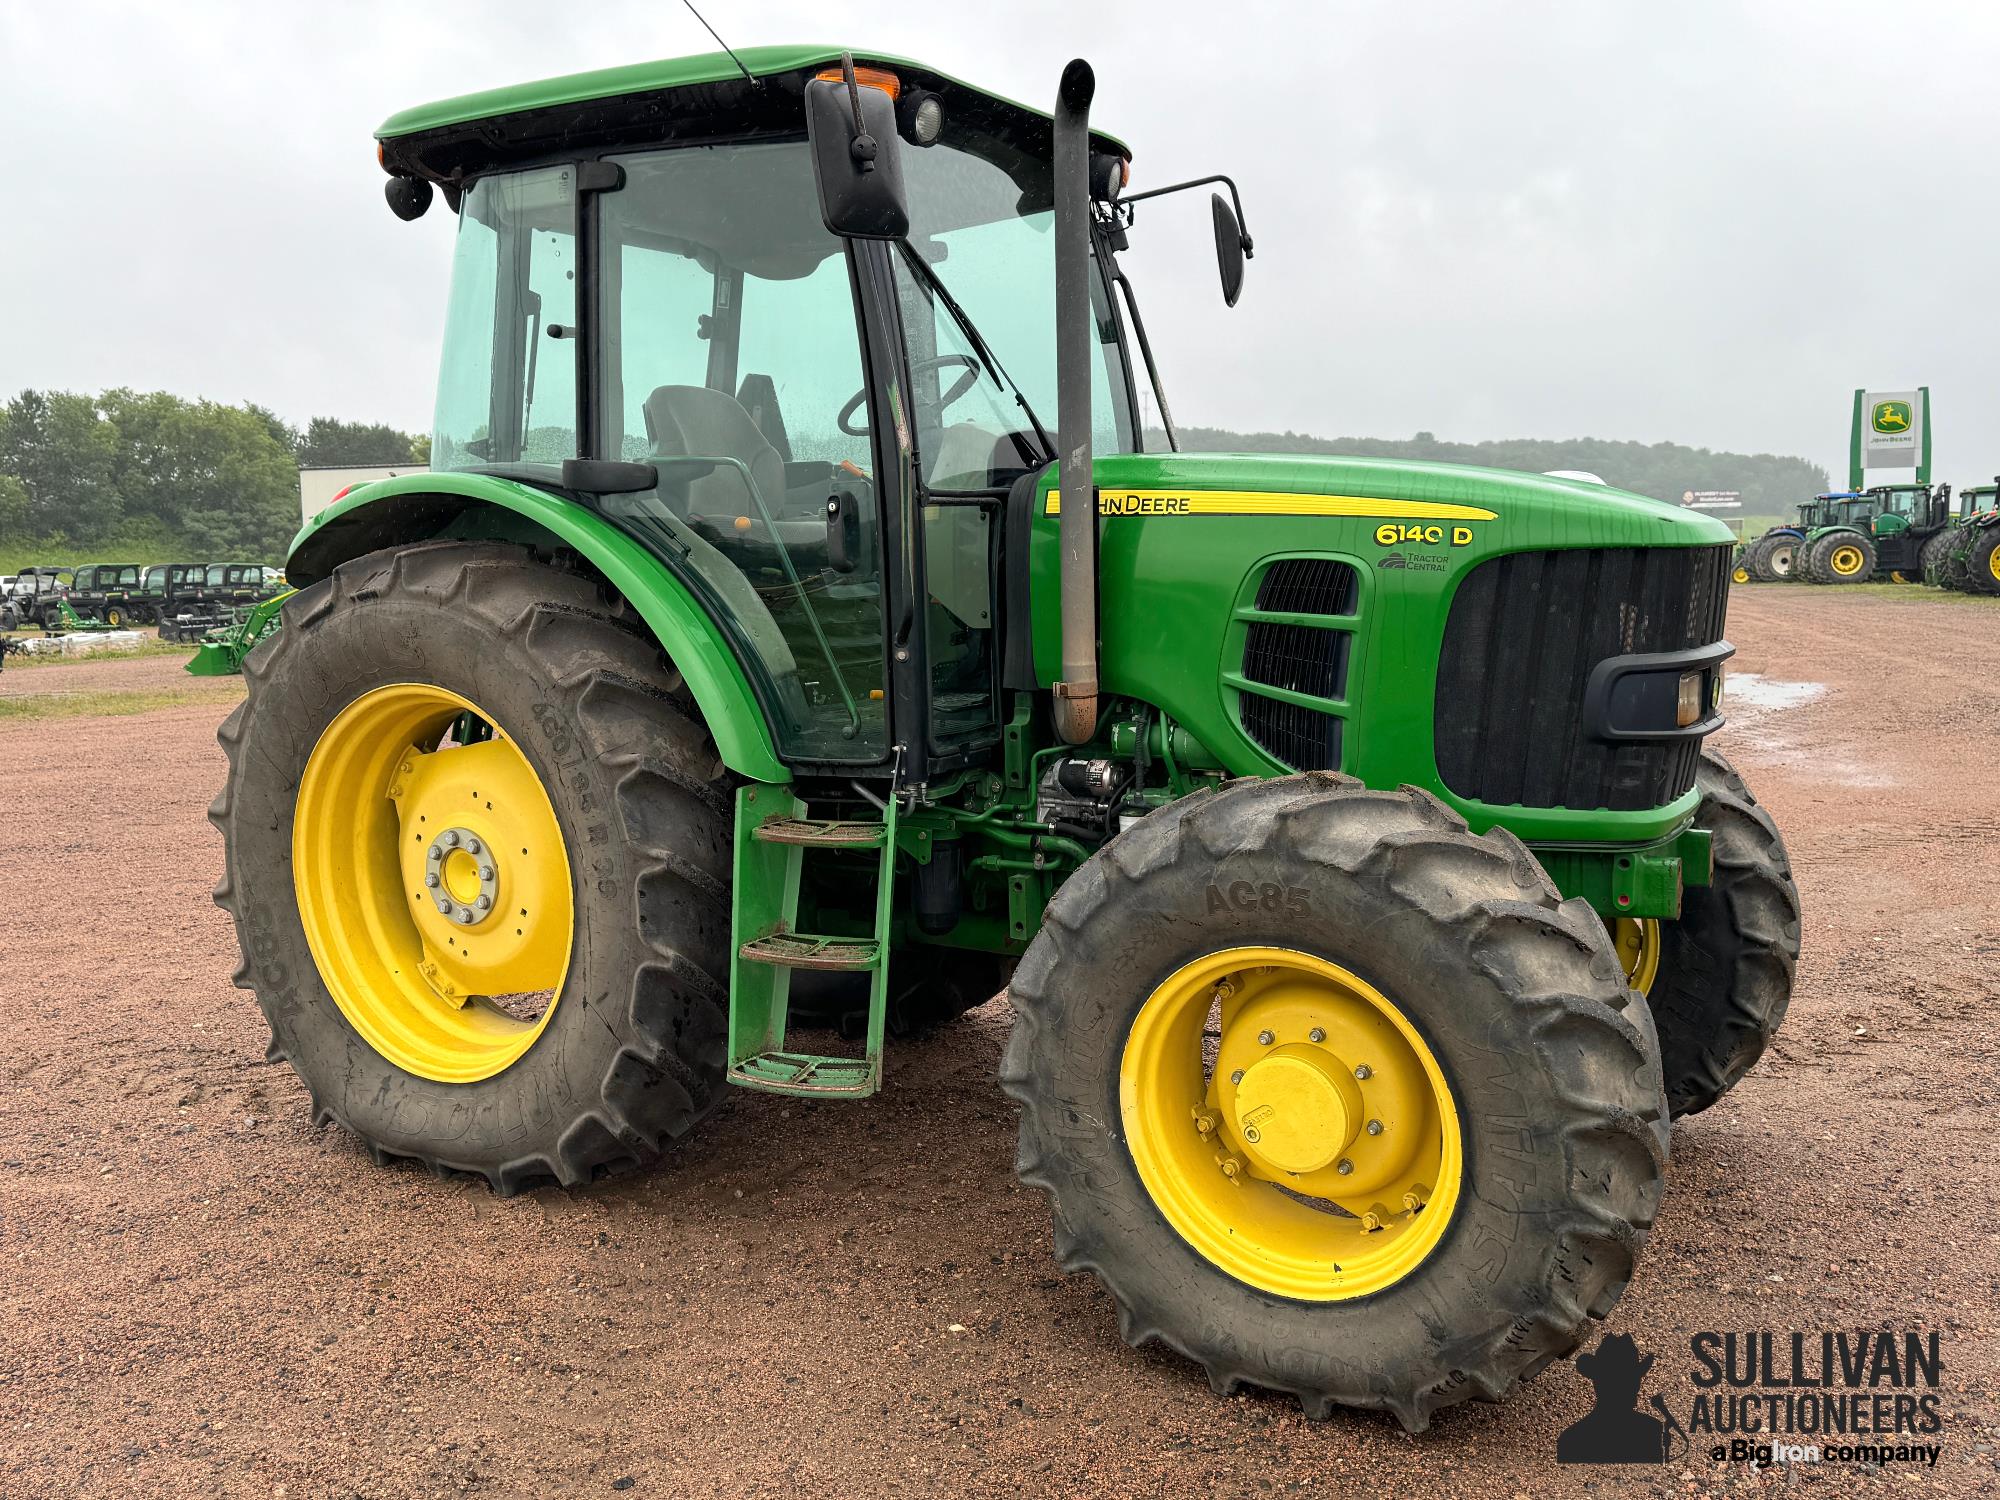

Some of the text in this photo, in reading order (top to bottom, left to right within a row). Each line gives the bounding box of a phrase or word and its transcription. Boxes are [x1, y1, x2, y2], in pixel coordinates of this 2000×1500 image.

[1126, 495, 1190, 512] DEERE
[1373, 524, 1474, 547] 6140 D
[1407, 552, 1449, 563] TRACTOR
[1406, 561, 1447, 572] CENTRAL
[1206, 880, 1312, 919] AC85
